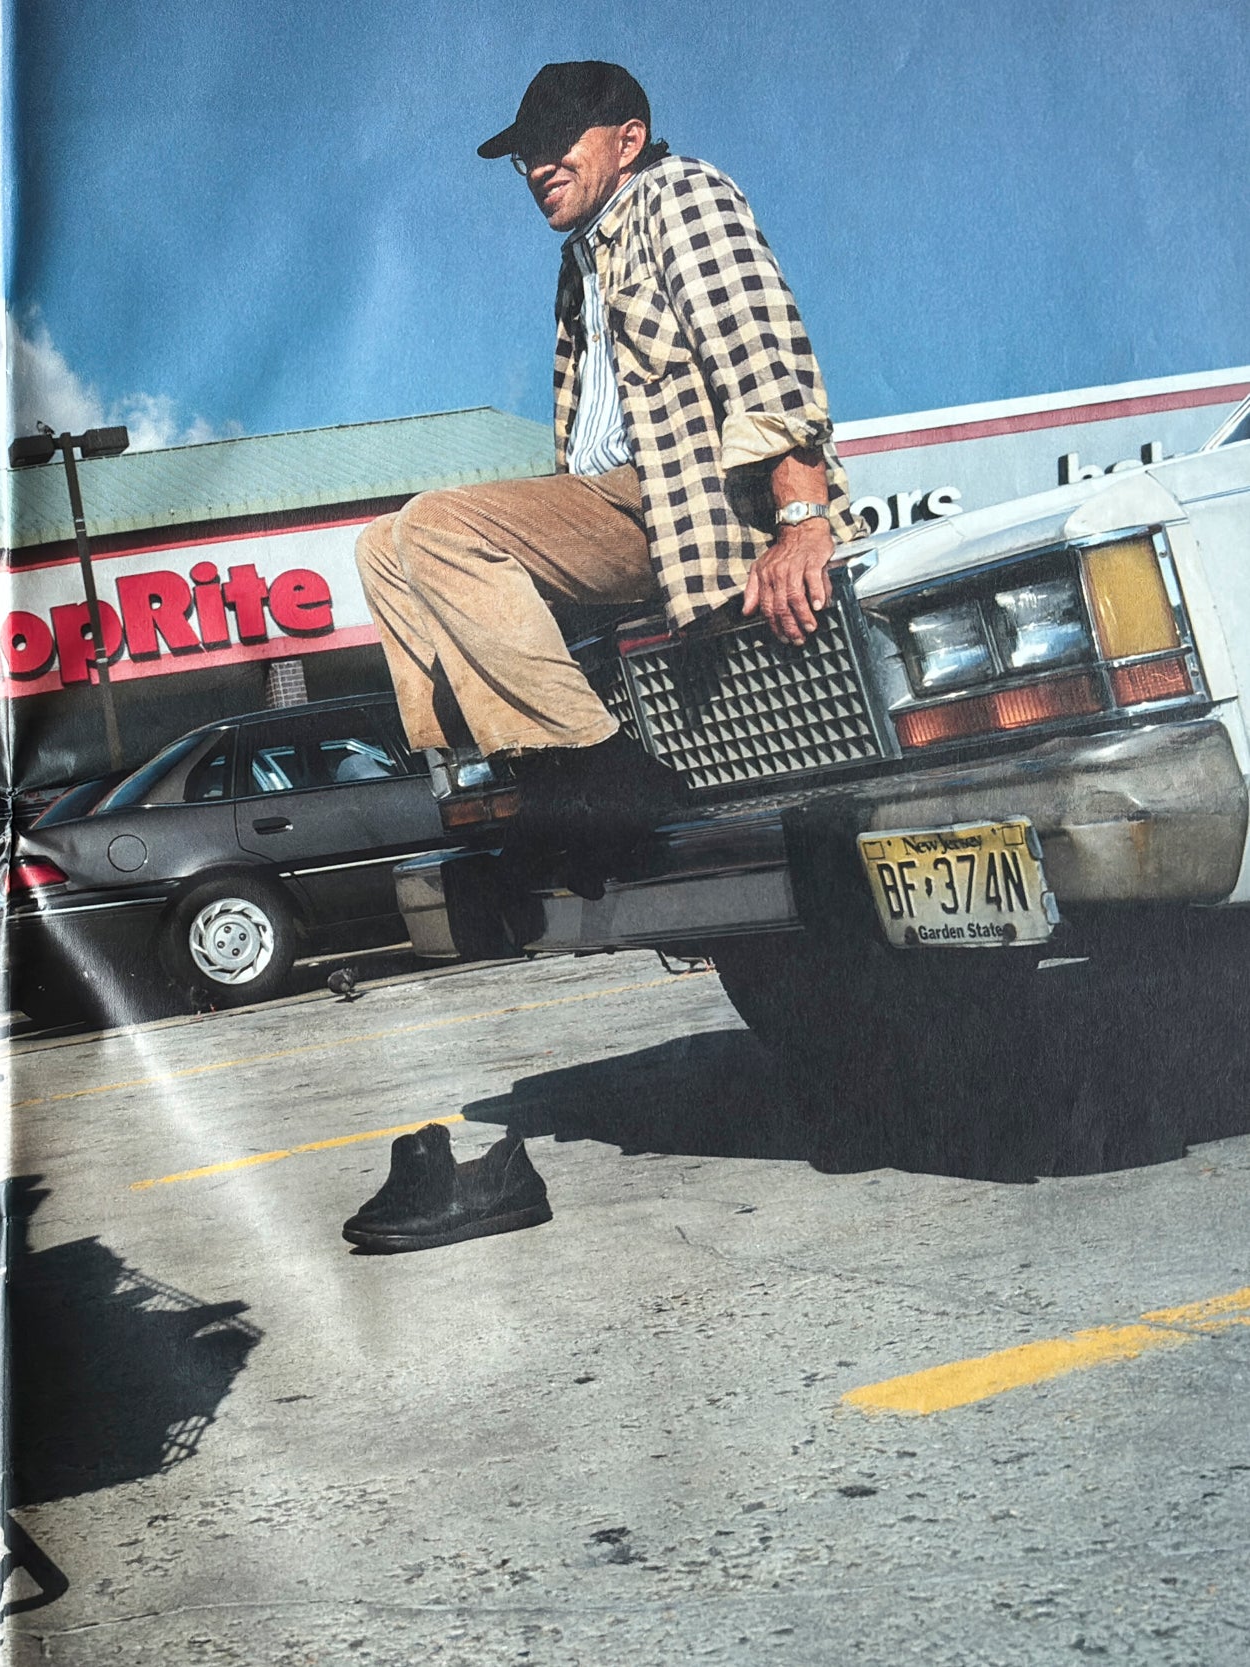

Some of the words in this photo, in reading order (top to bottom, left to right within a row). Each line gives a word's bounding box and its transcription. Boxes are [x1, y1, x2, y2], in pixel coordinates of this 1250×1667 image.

[902, 836, 938, 856] New
[937, 833, 982, 853] Jersey
[918, 924, 965, 940] Garden
[967, 921, 1003, 938] State
